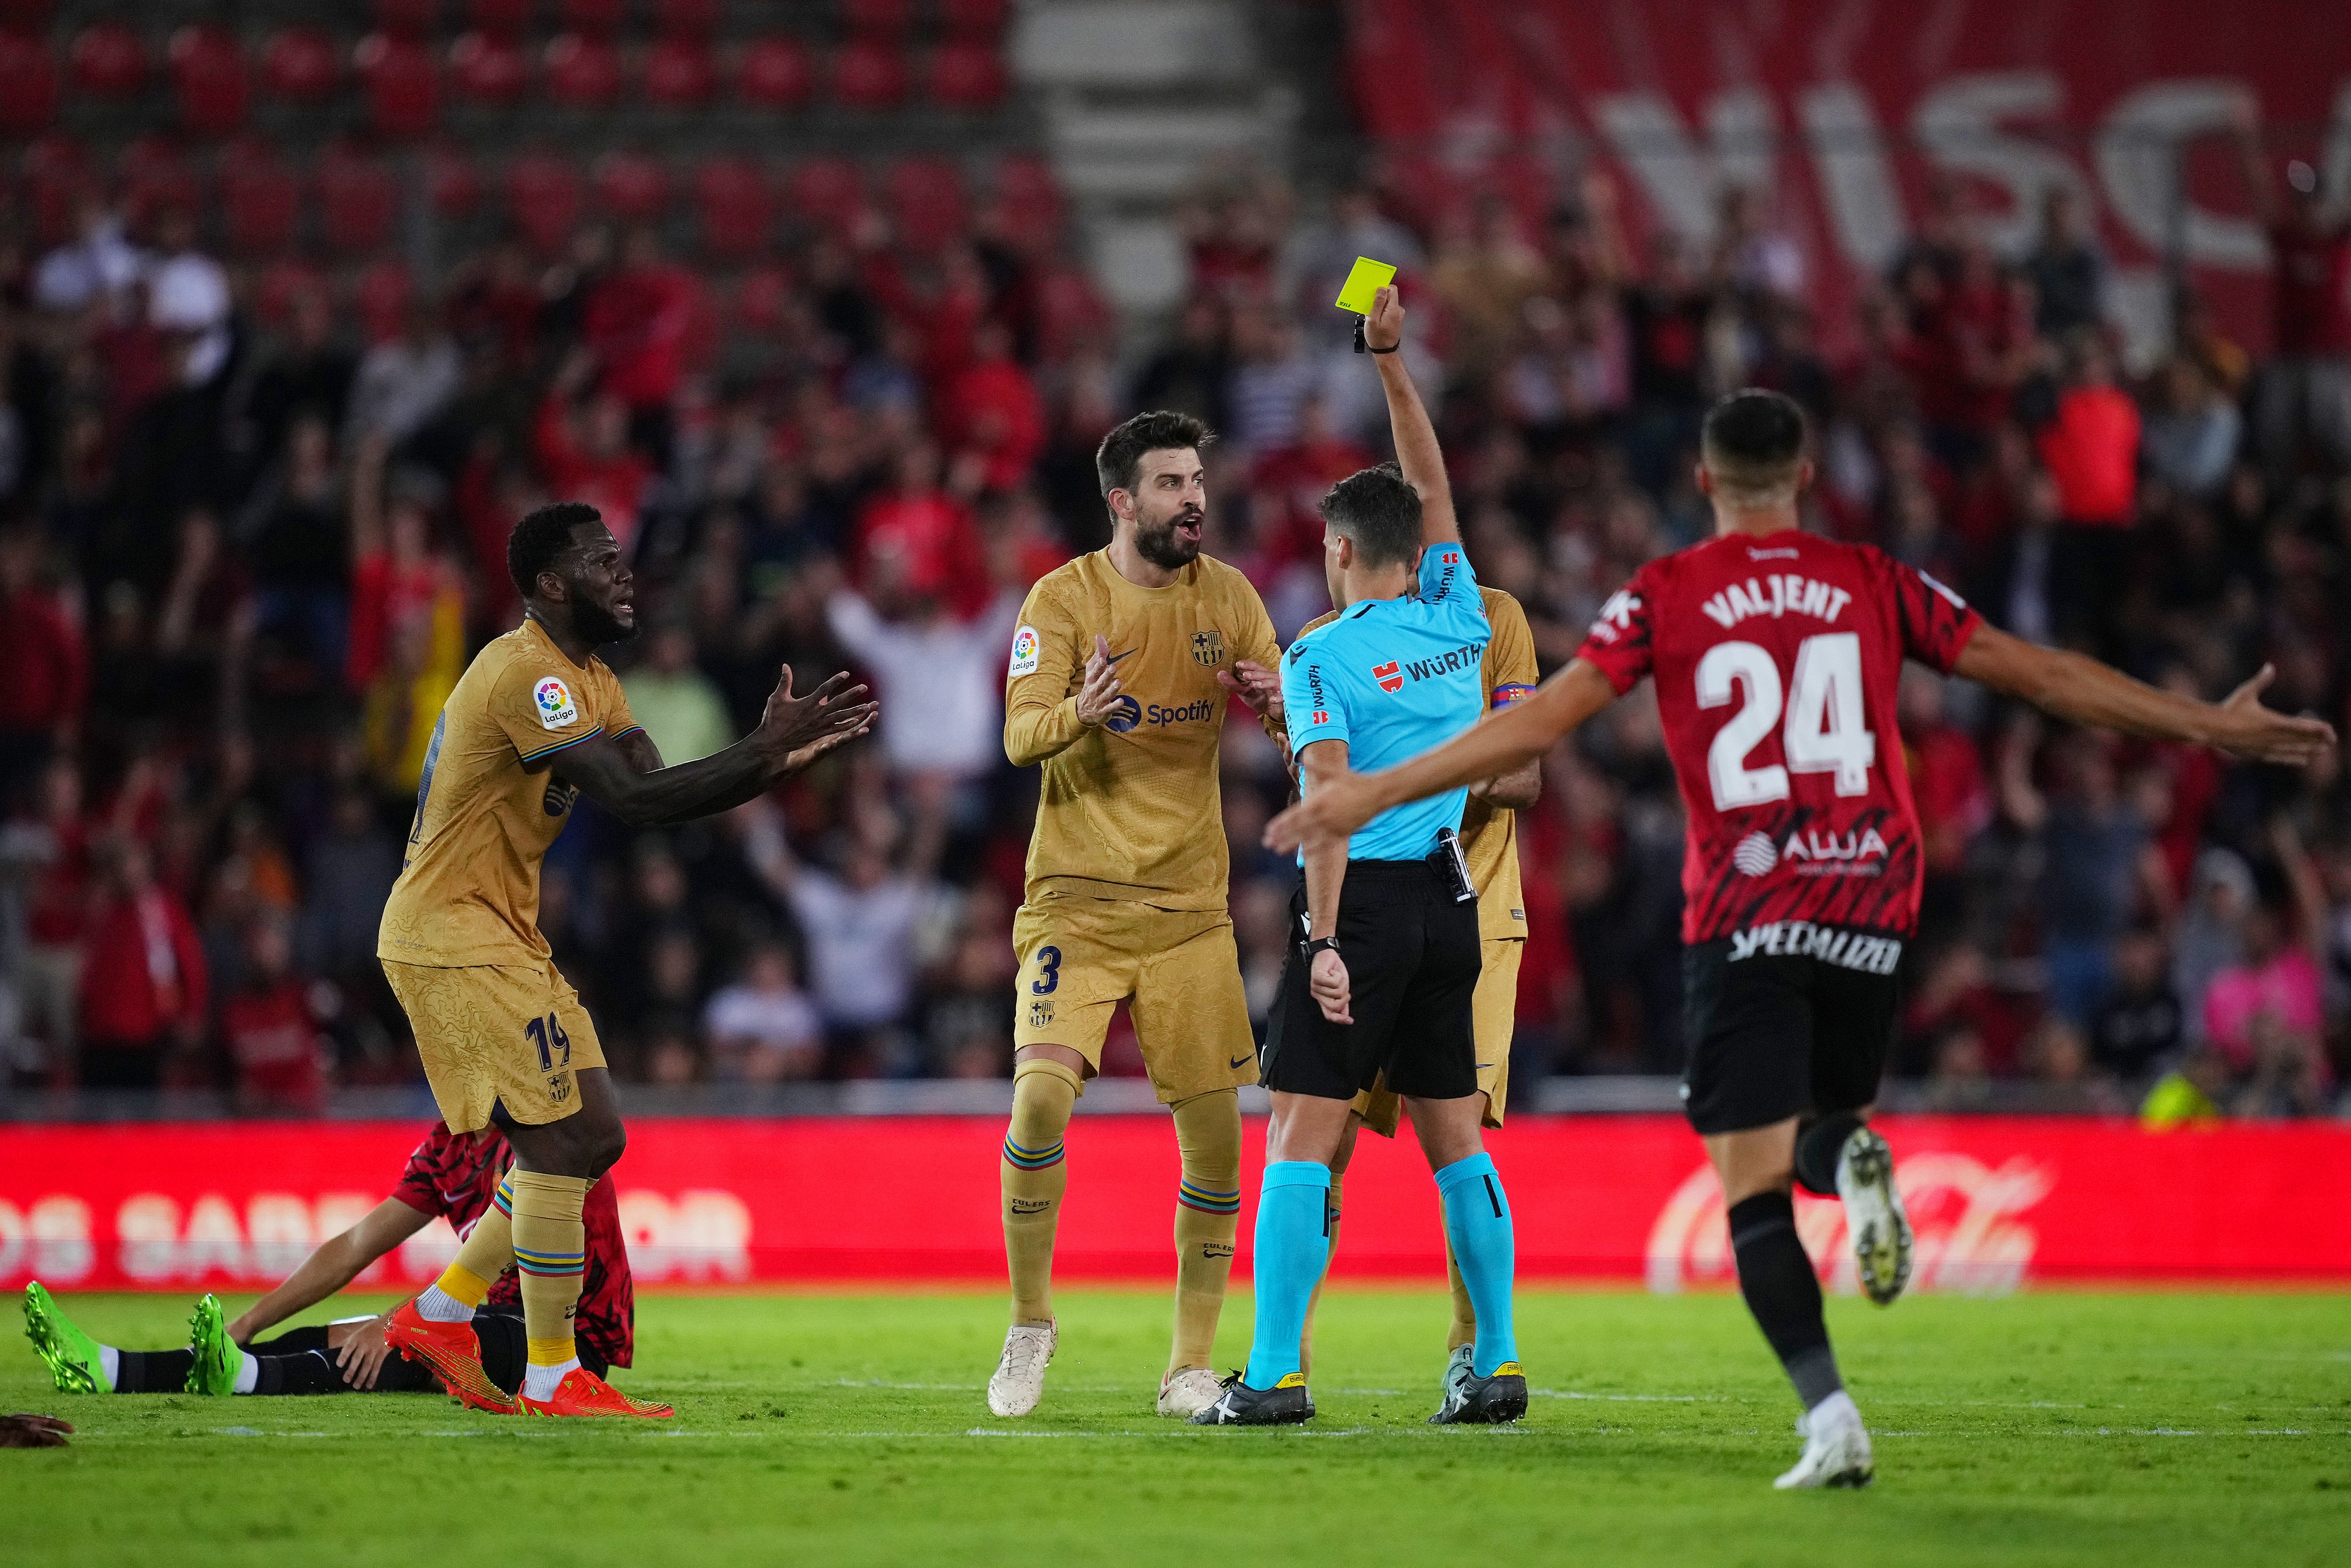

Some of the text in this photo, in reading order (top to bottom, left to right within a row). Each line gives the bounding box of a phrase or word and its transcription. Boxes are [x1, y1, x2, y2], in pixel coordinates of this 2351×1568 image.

[1595, 71, 2351, 269] VISC
[1702, 573, 1852, 630] VALJENT
[1013, 660, 1034, 670] LaLiga
[1405, 643, 1481, 682] WÜRTH
[1308, 665, 1325, 708] WÜRTH
[545, 709, 573, 722] LaLiga
[1147, 699, 1215, 727] Spotify
[1694, 631, 1876, 812] 24
[1030, 945, 1062, 996] 3
[524, 1011, 570, 1072] 19
[1012, 1198, 1051, 1207] CULERS
[1204, 1243, 1235, 1252] CULERS
[411, 1327, 429, 1335] PREDATOR
